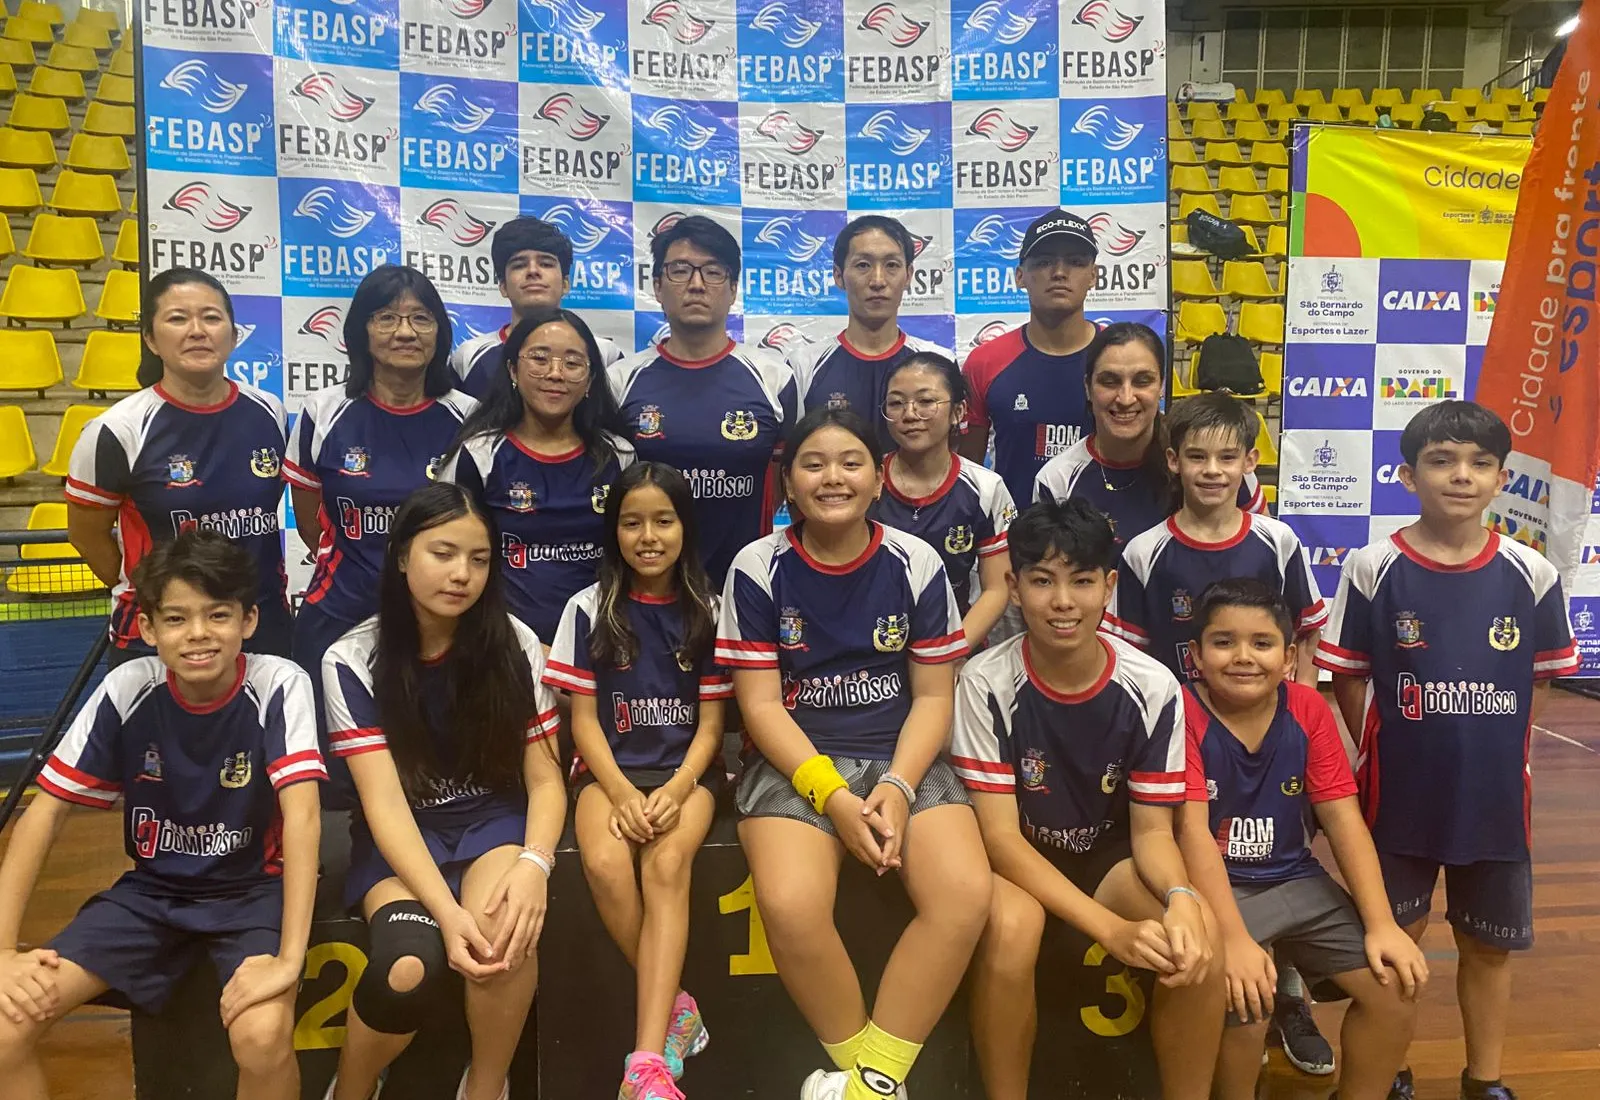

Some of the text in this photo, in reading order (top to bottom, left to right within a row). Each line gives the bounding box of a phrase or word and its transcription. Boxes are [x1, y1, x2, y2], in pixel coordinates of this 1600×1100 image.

[145, 0, 256, 29] FEBASP
[278, 6, 385, 46] FEBASP
[404, 22, 506, 59] FEBASP
[521, 32, 616, 68] FEBASP
[633, 50, 725, 80] FEBASP
[740, 54, 832, 84] FEBASP
[849, 54, 940, 82] FEBASP
[954, 51, 1048, 81] FEBASP
[1063, 48, 1154, 78] FEBASP
[149, 116, 261, 154] FEBASP
[280, 124, 387, 162] FEBASP
[403, 137, 505, 172] FEBASP
[523, 146, 620, 179] FEBASP
[635, 152, 727, 187] FEBASP
[744, 162, 835, 190] FEBASP
[849, 161, 940, 190] FEBASP
[957, 159, 1048, 188] FEBASP
[1063, 157, 1154, 186] FEBASP
[1424, 165, 1521, 190] Cidade
[152, 239, 265, 273] FEBASP
[1510, 69, 1591, 437] Cidade pra frente
[405, 251, 500, 286] FEBAS
[567, 260, 622, 289] ASP
[958, 266, 1029, 295] FEBA
[1090, 263, 1157, 291] BASP
[1300, 300, 1364, 309] São Bernardo
[1322, 309, 1355, 318] Campo
[1382, 290, 1462, 311] CAIXA
[1291, 327, 1335, 336] Esportes
[1343, 327, 1370, 336] Lazer
[1288, 376, 1368, 398] CAIXA
[1380, 377, 1457, 398] BRASIL
[1045, 424, 1082, 446] DOM
[703, 475, 753, 498] BOSCO
[1292, 474, 1358, 483] São Bernardo
[1313, 482, 1349, 492] Campo
[1284, 500, 1326, 510] Esportes
[1336, 500, 1364, 508] Lazer
[364, 513, 395, 535] DO
[799, 673, 902, 708] DOM BOSCO
[1424, 681, 1495, 691] COLÉGIO
[660, 703, 695, 726] BOSC
[1424, 691, 1517, 716] DOM BOSCO
[160, 826, 253, 857] DOM BOSCO
[1229, 817, 1274, 843] DOM
[1230, 843, 1273, 856] BOSCO
[718, 874, 779, 976] 1
[1473, 917, 1518, 939] SAILOR
[294, 942, 369, 1050] 2
[1080, 942, 1146, 1037] 3
